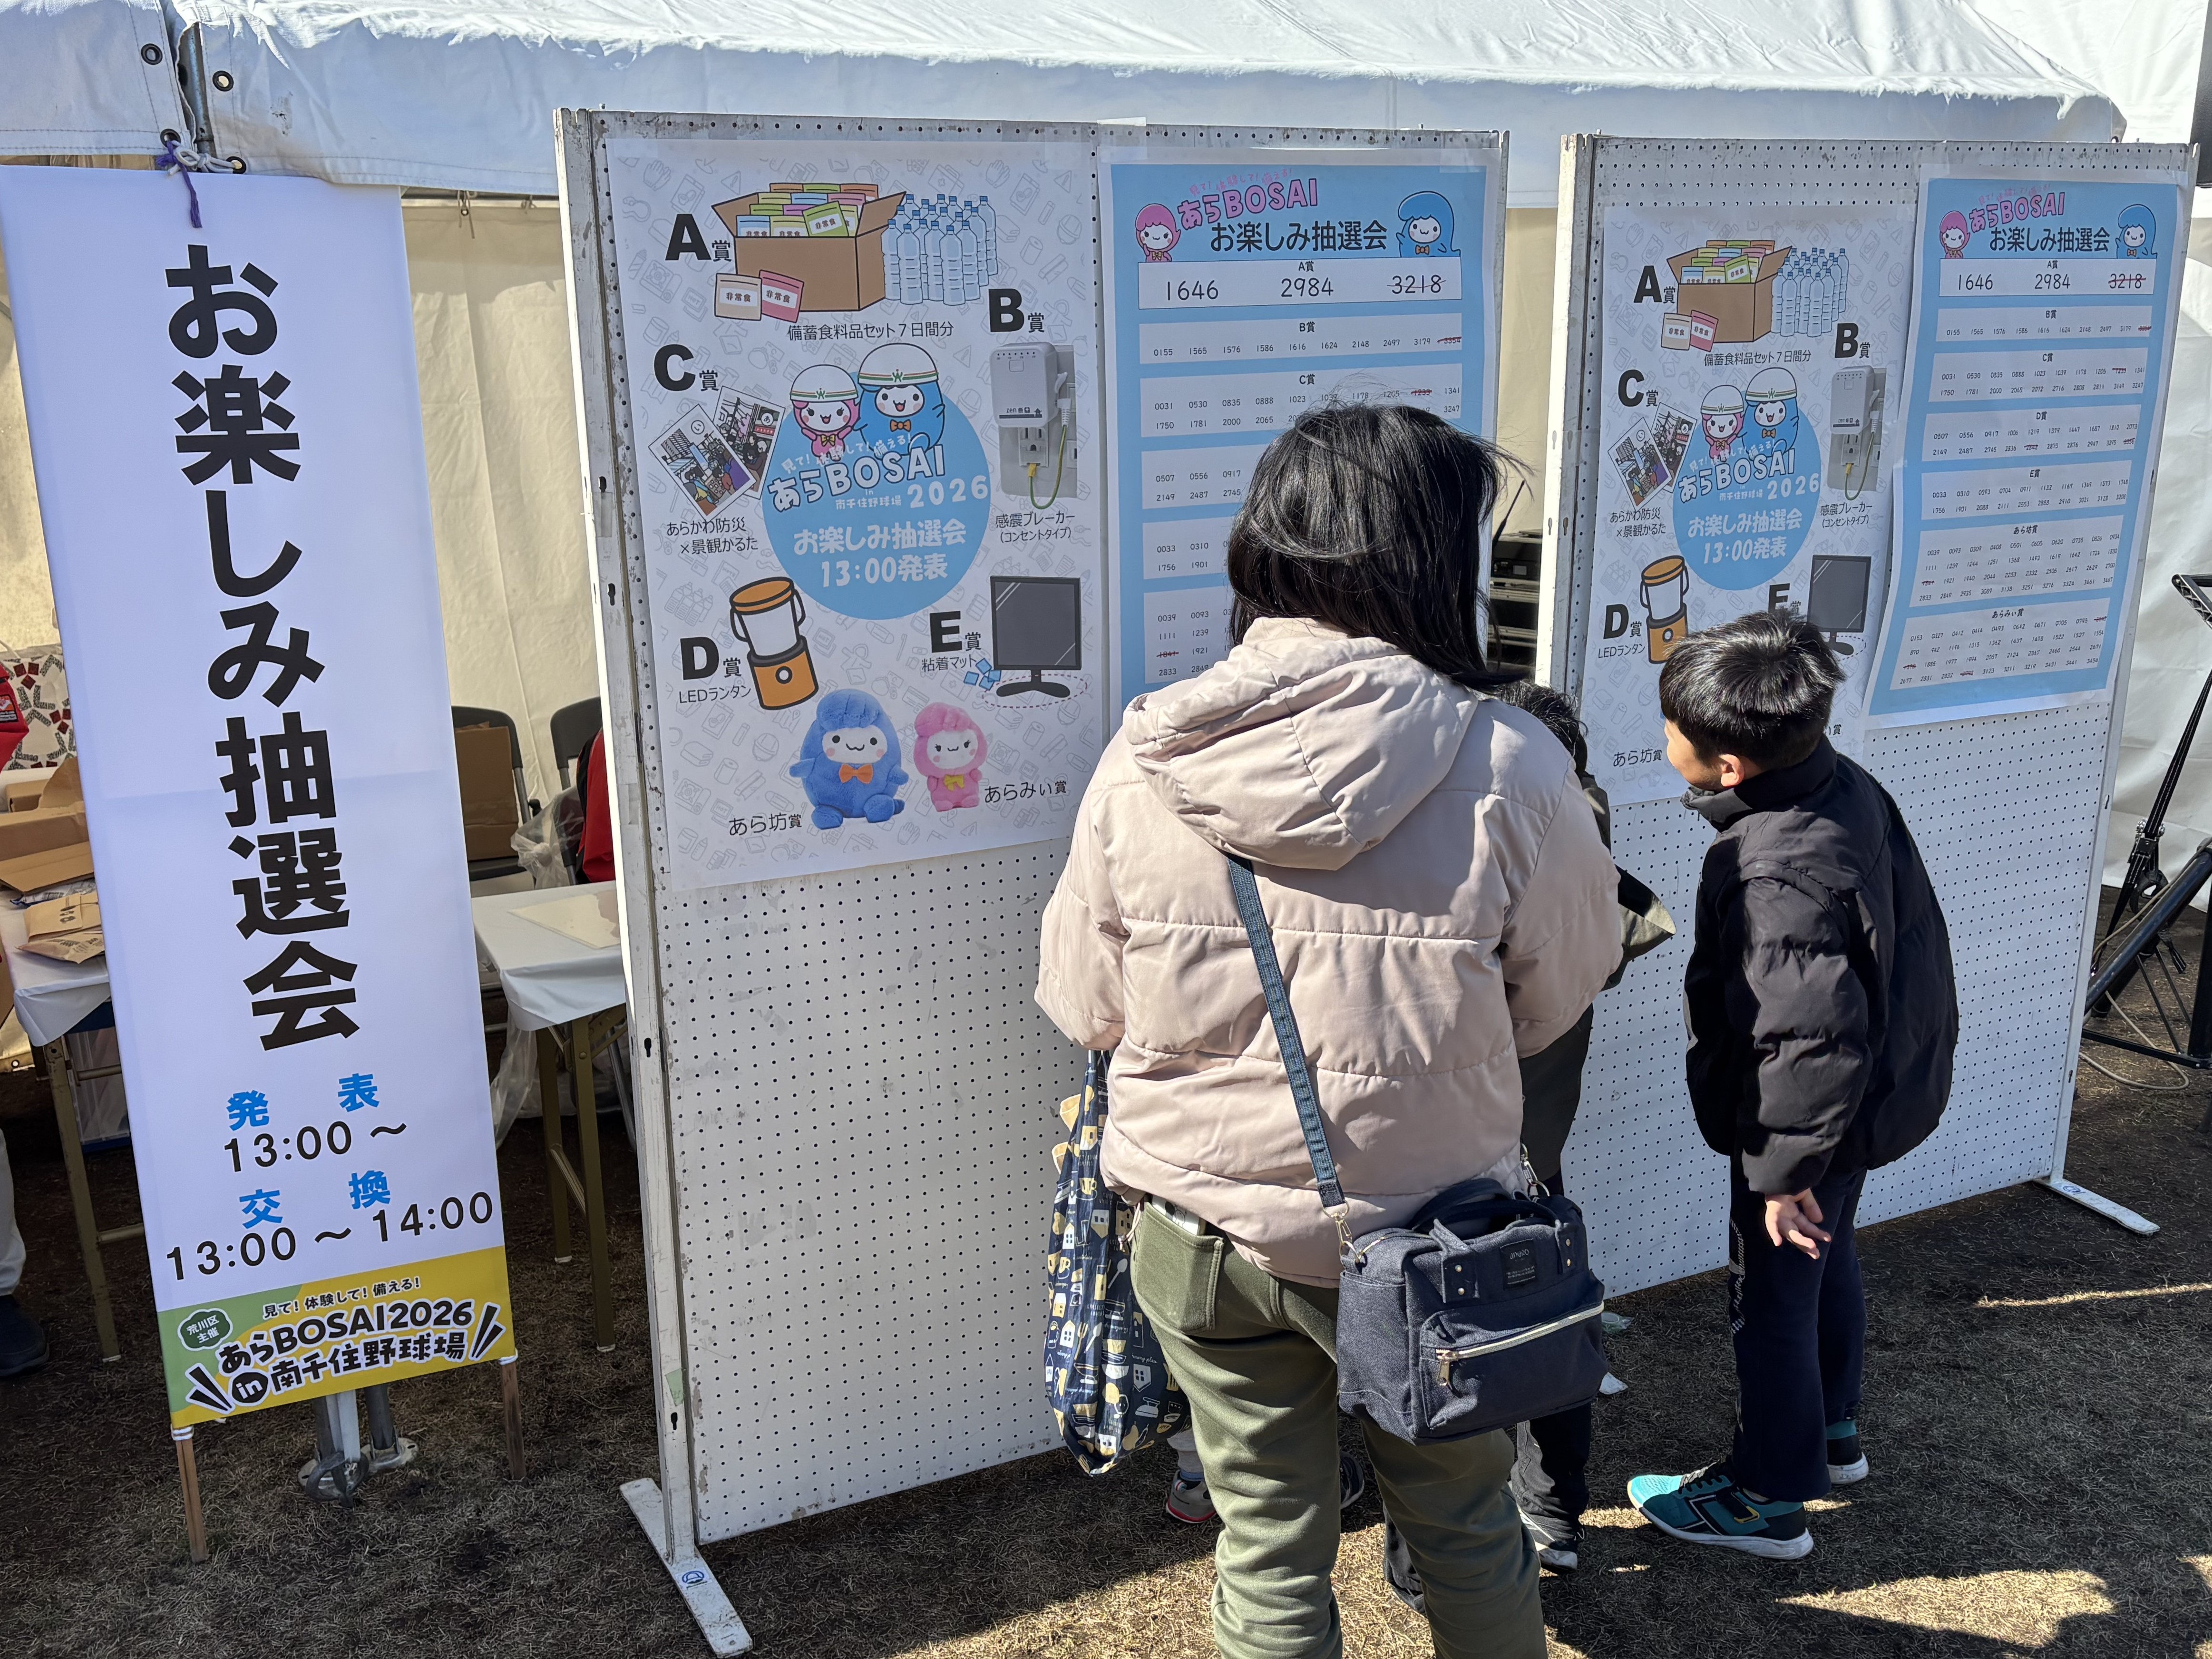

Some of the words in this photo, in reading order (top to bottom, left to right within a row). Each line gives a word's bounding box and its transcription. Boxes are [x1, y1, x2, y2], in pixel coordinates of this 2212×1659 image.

[1177, 178, 1317, 230] あらBOSAI
[1969, 192, 2065, 233] あらBOSAI
[815, 218, 836, 229] 非常食
[1210, 220, 1387, 253] お楽しみ抽選会
[665, 214, 731, 262] A賞
[1990, 226, 2110, 252] お楽しみ抽選会
[1298, 261, 1314, 273] A賞
[2047, 260, 2058, 269] A賞
[1166, 280, 1219, 301] 1646
[1280, 278, 1334, 297] 2984
[1391, 274, 1442, 295] 3218
[1633, 265, 1676, 304] A賞
[1958, 273, 1993, 290] 1646
[2034, 273, 2071, 289] 2984
[2109, 273, 2143, 289] 3218
[726, 292, 751, 302] 非常食
[766, 290, 790, 303] 非常食
[988, 289, 1045, 333] B賞
[1299, 322, 1315, 333] B賞
[1834, 322, 1871, 359] B賞
[653, 344, 718, 391] C賞
[1299, 373, 1315, 385] C賞
[1618, 369, 1658, 407] C賞
[767, 444, 945, 512] あらBOSAI
[1678, 448, 1795, 503] あらBOSAI
[1767, 473, 1819, 500] 2026
[835, 495, 902, 509] 南千住野球場
[907, 475, 988, 508] 2026
[995, 511, 1075, 529] 感震ブレーカー
[1610, 507, 1661, 523] あらかわ防災
[1688, 507, 1802, 538] お楽しみ抽選会
[1821, 502, 1872, 516] 感震ブレーカー
[666, 517, 746, 537] あらかわ防災
[794, 518, 966, 556] お楽しみ抽選会
[1704, 537, 1787, 564] 13:00発表
[820, 553, 948, 588] 13:00発表
[1191, 611, 1208, 619] 0093
[1603, 604, 1642, 639] D賞
[930, 611, 981, 654] E賞
[164, 243, 360, 1052] お楽しみ抽選会
[679, 637, 741, 681] D賞
[1598, 643, 1645, 659] LEDランタン
[922, 655, 977, 672] 粘着マット
[679, 684, 751, 703] LEDランタン
[1613, 749, 1662, 767] あら坊賞
[728, 813, 802, 833] あら坊賞
[224, 1121, 351, 1173] 13:00
[166, 1227, 296, 1280] 13:00
[373, 1192, 493, 1242] 14:00
[186, 1315, 219, 1335] 荒川区
[197, 1327, 220, 1343] 主催
[218, 1300, 472, 1374] あらBOSAI2026
[236, 1380, 263, 1399] in
[272, 1332, 466, 1392] 南千住野球場
